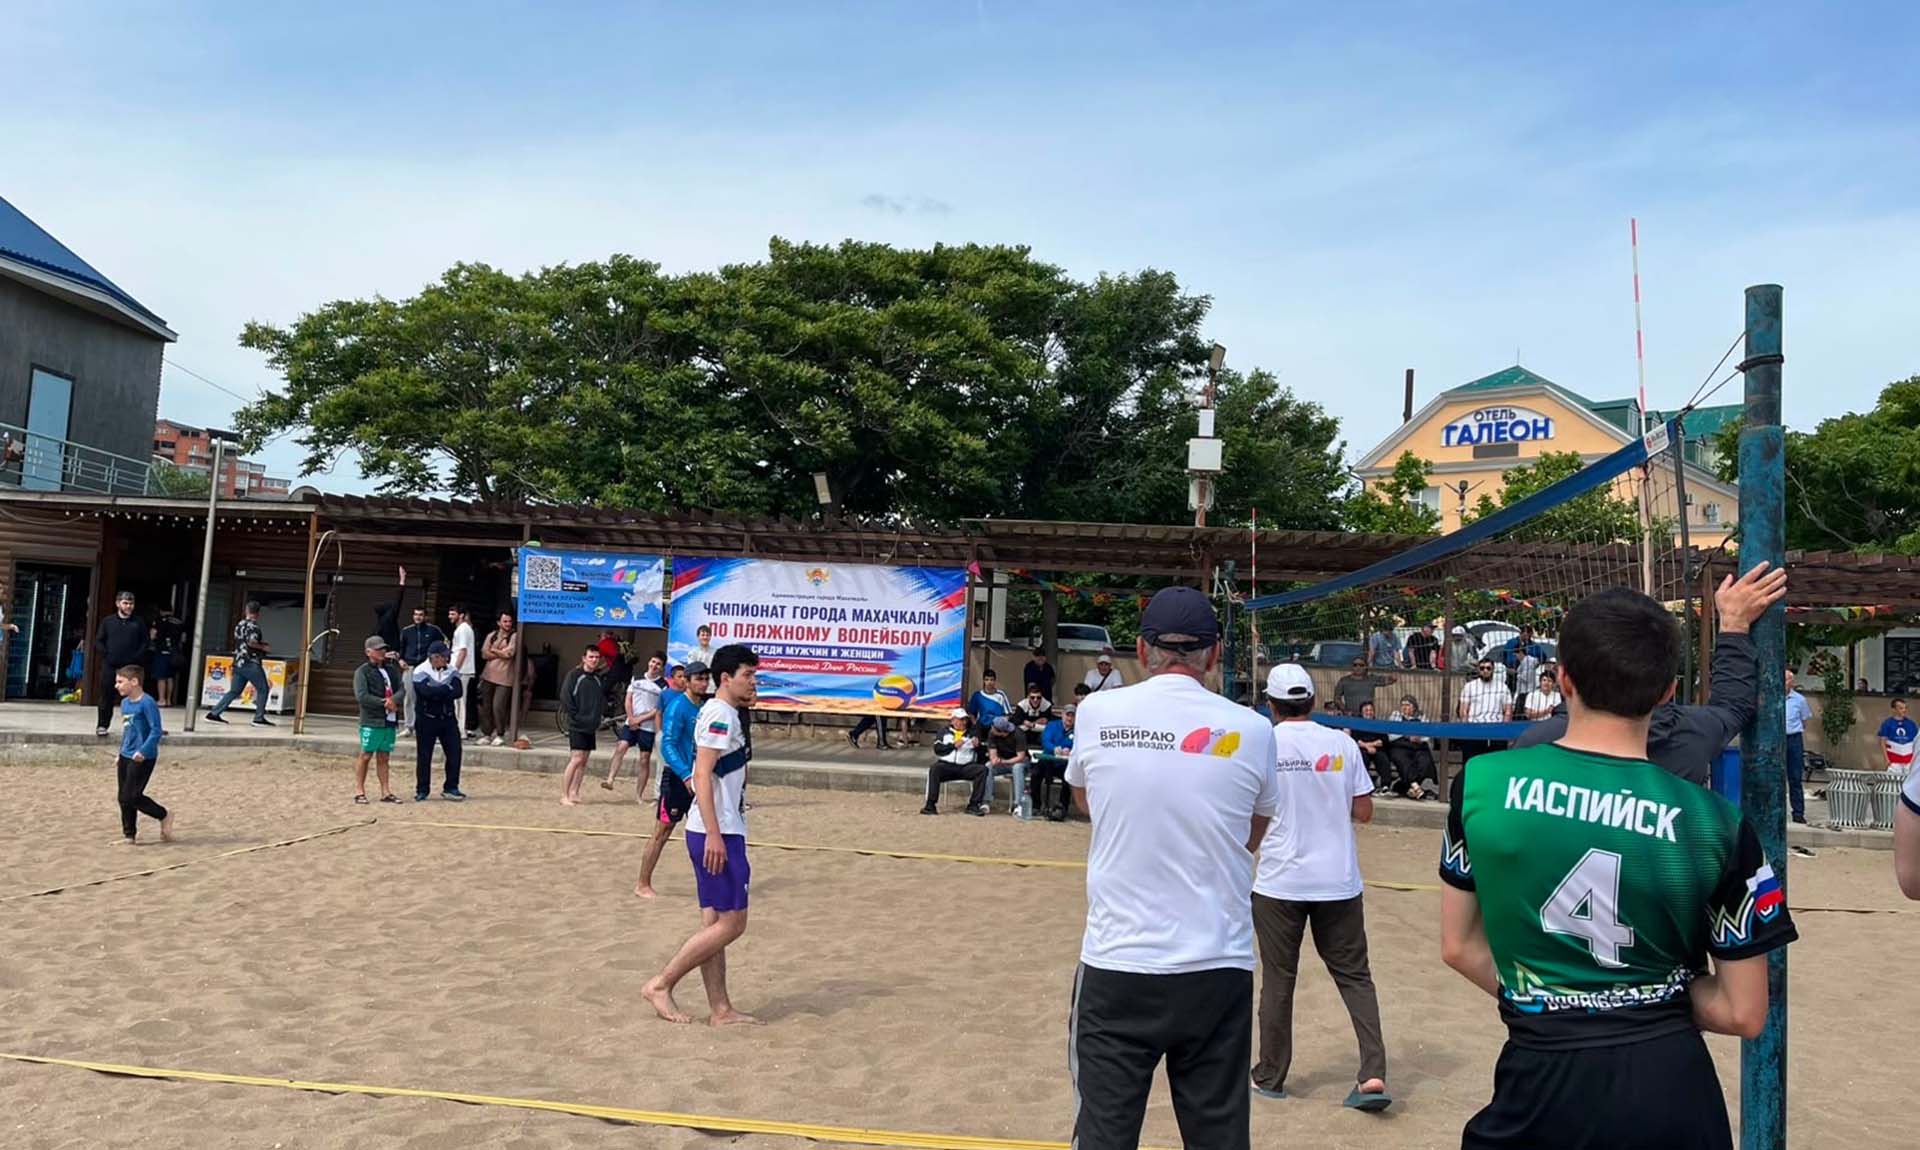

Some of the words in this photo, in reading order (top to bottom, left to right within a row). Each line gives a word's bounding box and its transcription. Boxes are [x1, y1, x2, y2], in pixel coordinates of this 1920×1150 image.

[1473, 408, 1517, 422] ОТЕЛЬ
[1444, 417, 1551, 447] ГАЛЕОН
[703, 602, 787, 619] ЧЕМПИОНАТ
[792, 605, 847, 622] ГОРОДА
[852, 608, 940, 626] МАХАЧКАЛЫ
[708, 622, 728, 637] ПО
[733, 623, 831, 642] ПЛЯЖНОМУ
[838, 626, 933, 646] ВОЛЕЙБОЛУ
[751, 645, 782, 655] СРЕДИ
[785, 646, 829, 657] МУЖЧИН
[831, 648, 838, 657] И
[840, 648, 884, 659] ЖЕНЩИН
[846, 662, 878, 673] России
[1100, 729, 1176, 743] ВЫБИРАЮ
[1101, 740, 1135, 748] ЧИСТЫЙ
[1137, 741, 1176, 751] ВОЗДУХ
[1276, 759, 1312, 768] ЫБИРАЮ
[1504, 776, 1682, 842] КАСПИЙСК
[1540, 847, 1634, 968] 4
